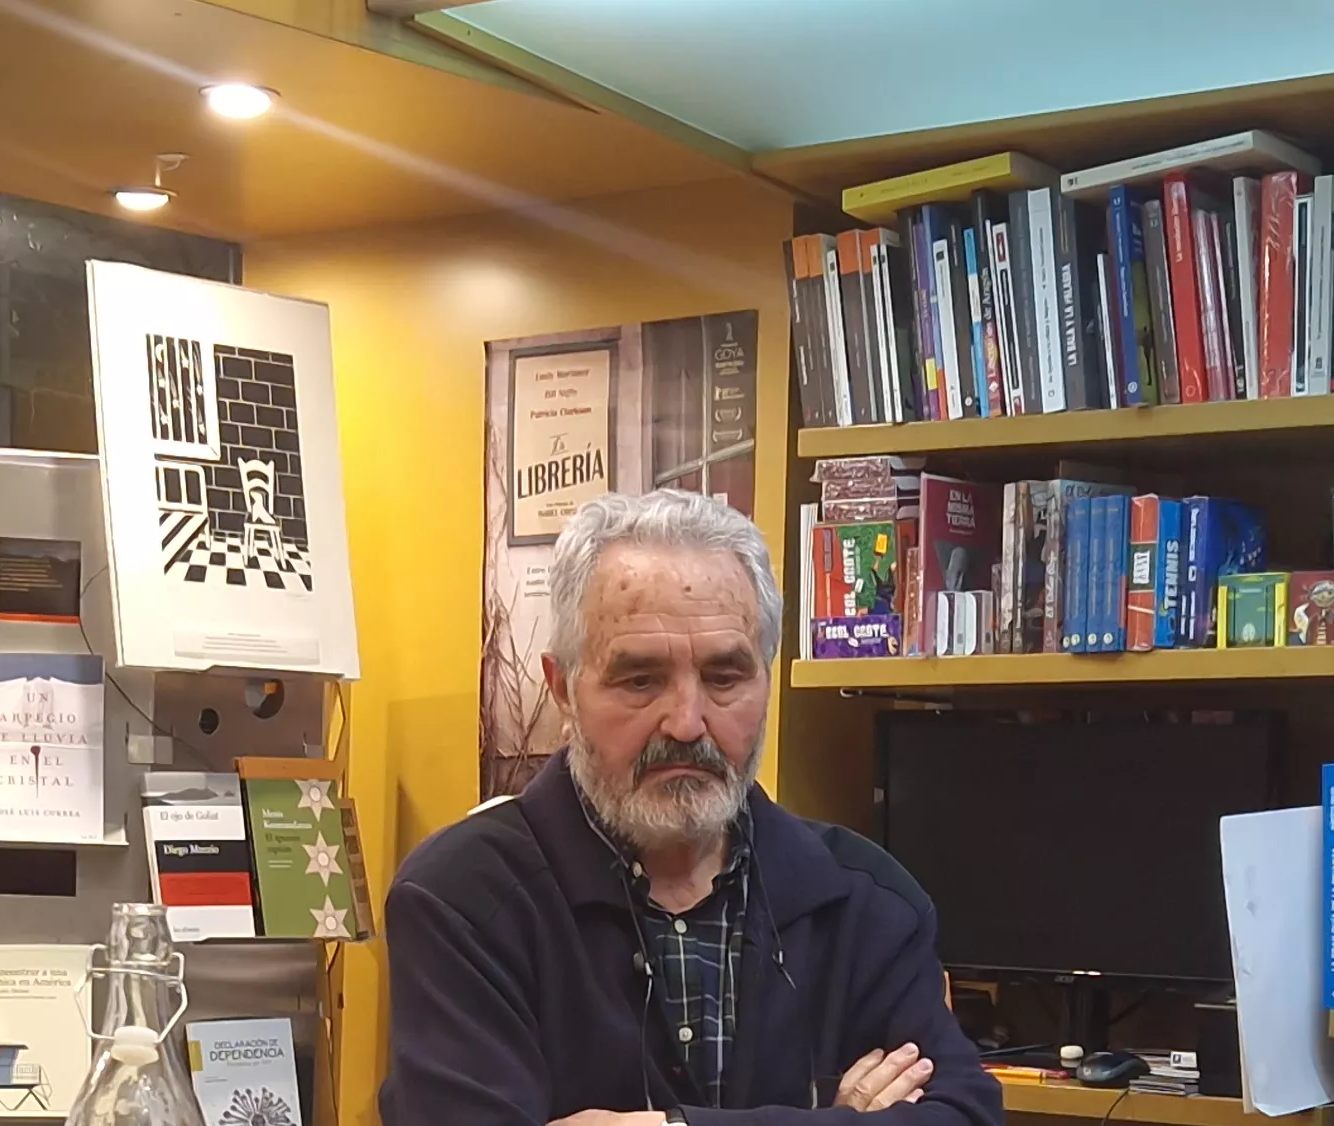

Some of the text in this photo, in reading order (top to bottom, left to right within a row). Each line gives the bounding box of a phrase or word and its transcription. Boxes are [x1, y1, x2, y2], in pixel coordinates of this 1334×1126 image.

[517, 441, 605, 500] LIBRERÍA
[1165, 539, 1181, 610] TENNIS
[9, 754, 64, 767] EN EL
[185, 811, 194, 821] de
[209, 1048, 285, 1062] DEPENDENCIA
